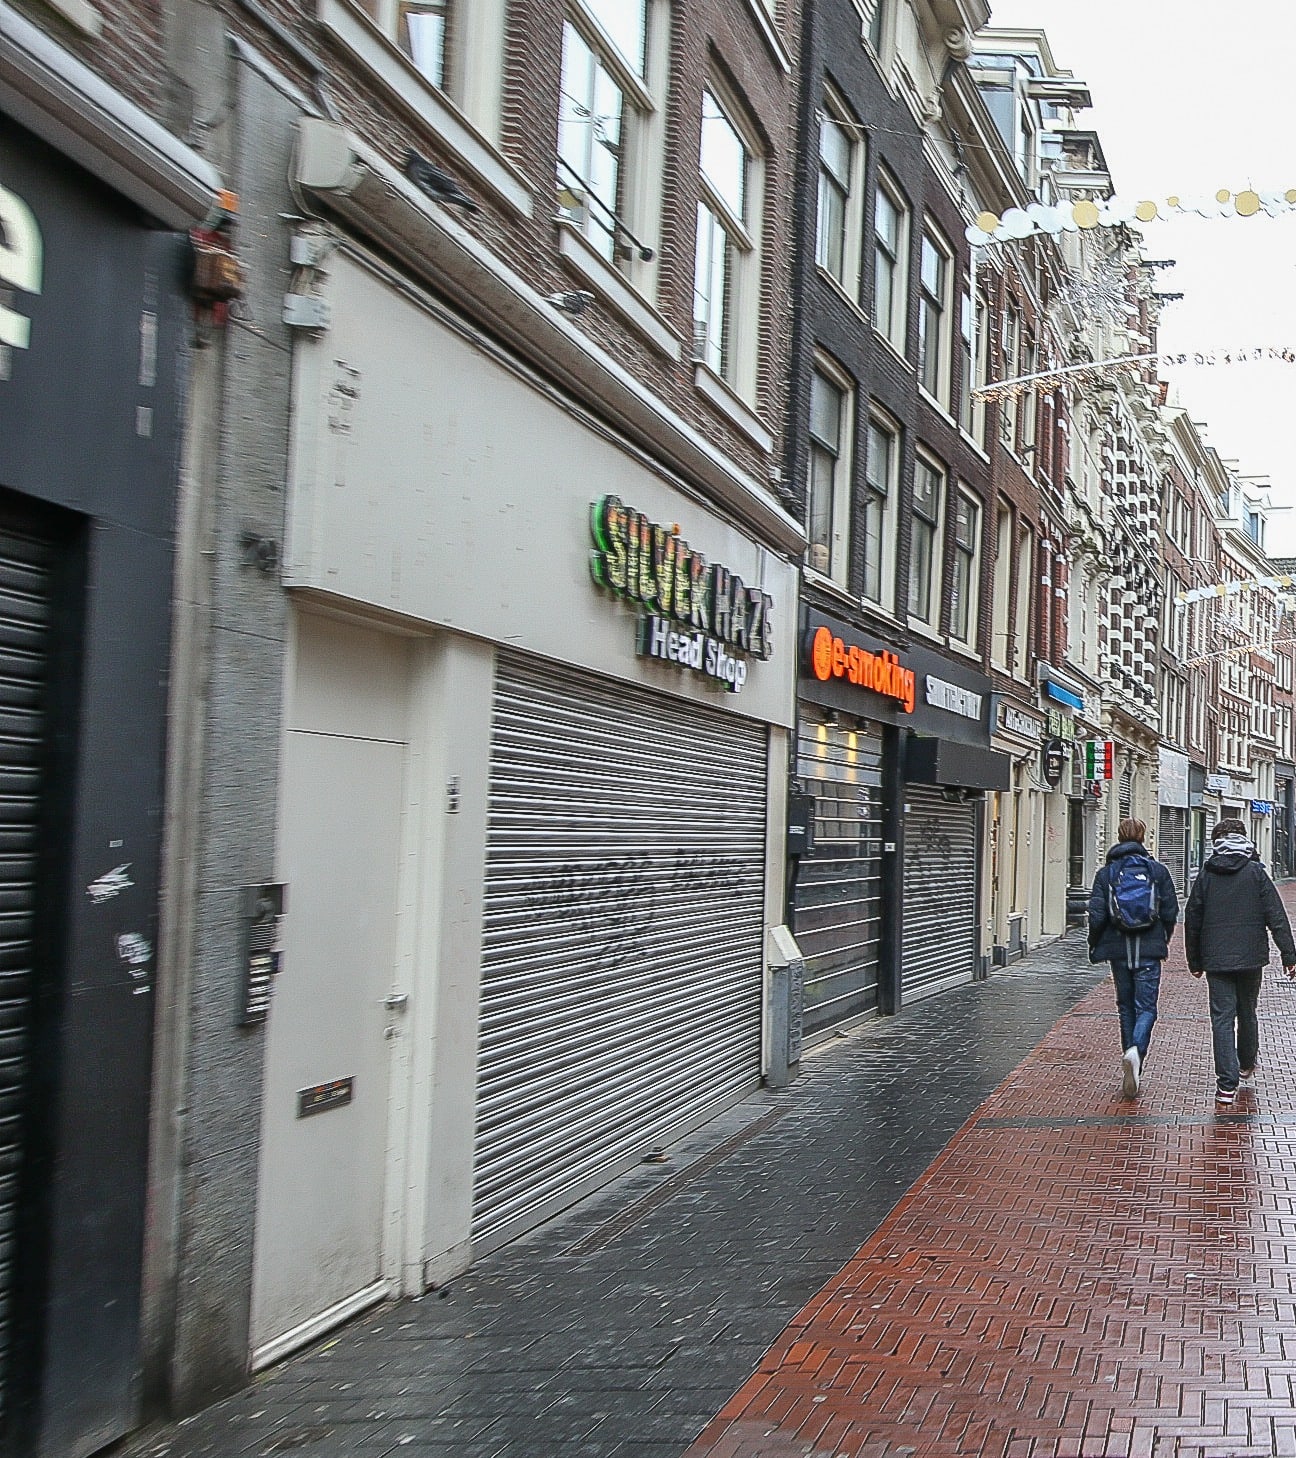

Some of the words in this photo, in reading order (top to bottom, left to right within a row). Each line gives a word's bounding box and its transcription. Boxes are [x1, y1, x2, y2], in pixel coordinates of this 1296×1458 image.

[712, 563, 773, 660] HAZE
[651, 615, 704, 669] Head
[705, 636, 747, 693] Shop
[832, 637, 914, 714] e-smoking
